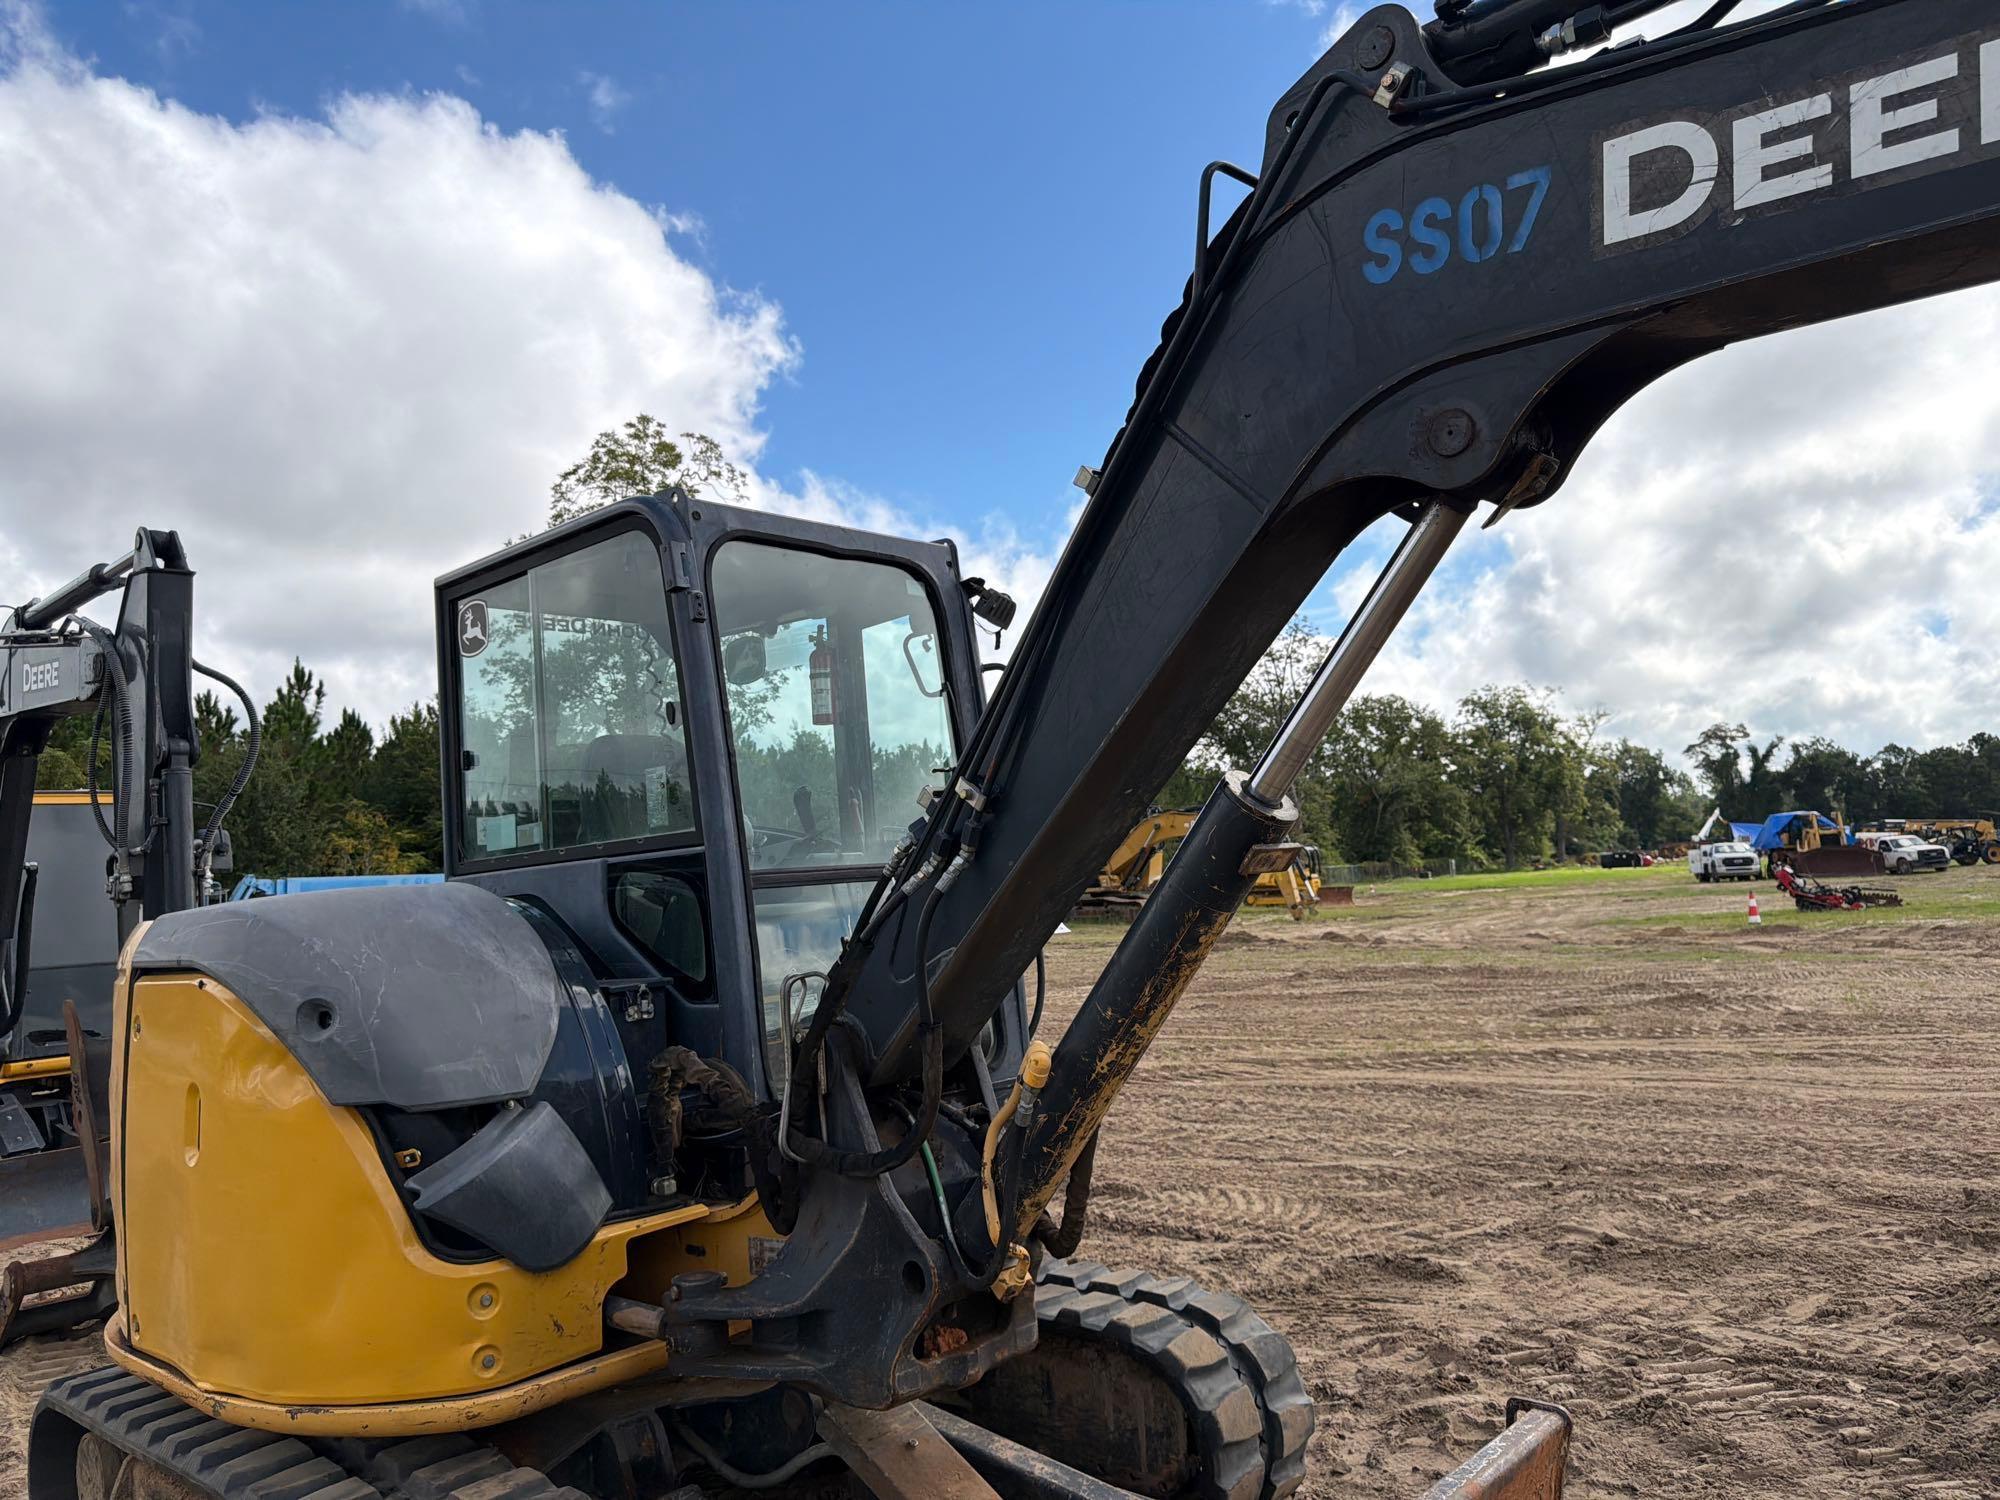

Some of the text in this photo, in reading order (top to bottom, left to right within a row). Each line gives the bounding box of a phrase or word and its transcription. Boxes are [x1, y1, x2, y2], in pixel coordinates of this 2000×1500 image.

[1603, 38, 2000, 245] DEE
[1362, 166, 1551, 284] SS07
[23, 661, 59, 692] DEERE
